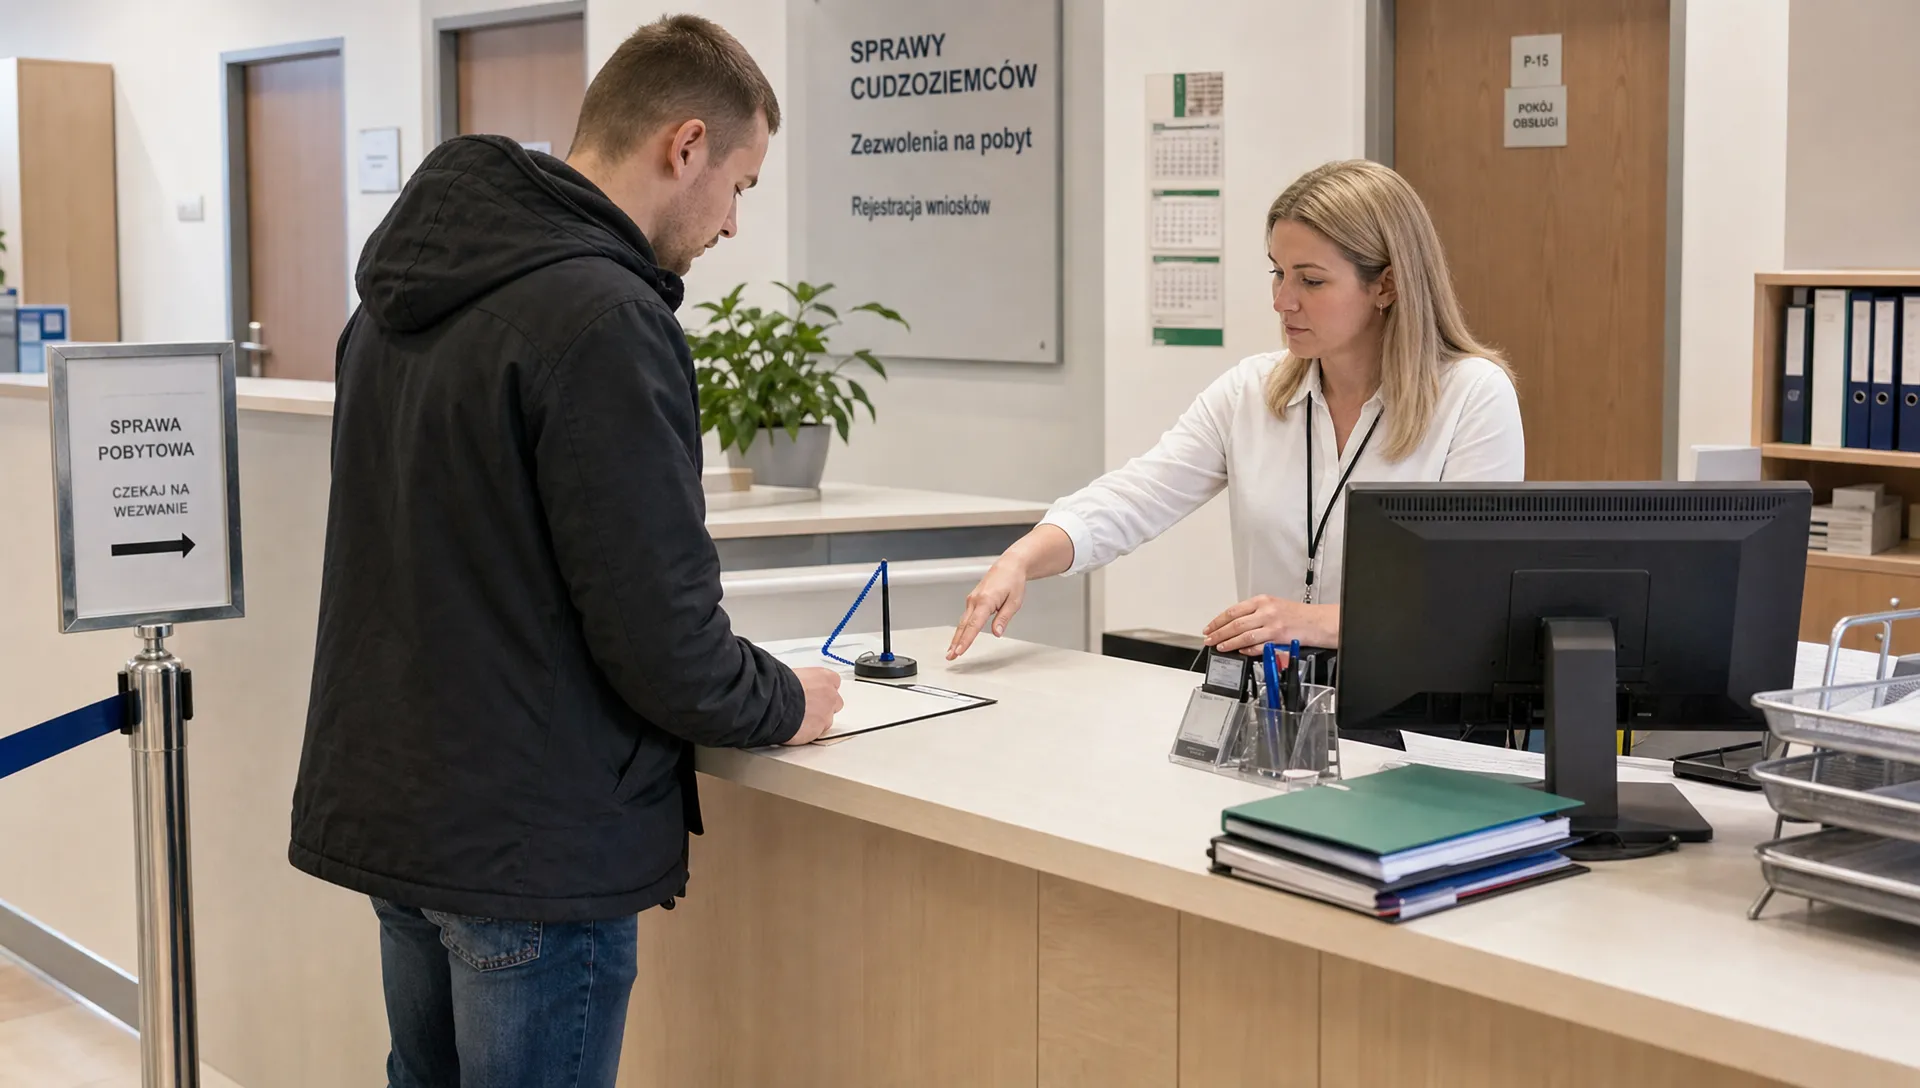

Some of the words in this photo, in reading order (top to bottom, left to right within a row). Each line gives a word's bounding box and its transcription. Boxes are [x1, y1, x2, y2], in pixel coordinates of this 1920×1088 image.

[851, 33, 946, 64] SPRAWY
[1524, 54, 1549, 68] P-15
[851, 60, 1038, 100] CUDZOZIEMCÓW
[1518, 100, 1553, 113] POKÓJ
[1513, 117, 1558, 129] OBSŁUGI
[851, 130, 948, 155] Zezwolenia
[954, 135, 975, 151] na
[981, 127, 1032, 155] pobyt
[851, 195, 922, 221] Rejestracja
[927, 195, 990, 216] wniosków
[110, 417, 182, 434] SPRAWA
[99, 442, 195, 461] POBYTOWA
[112, 484, 166, 499] CZEKAJ
[171, 483, 190, 496] NA
[114, 502, 188, 518] WEZWANIE
